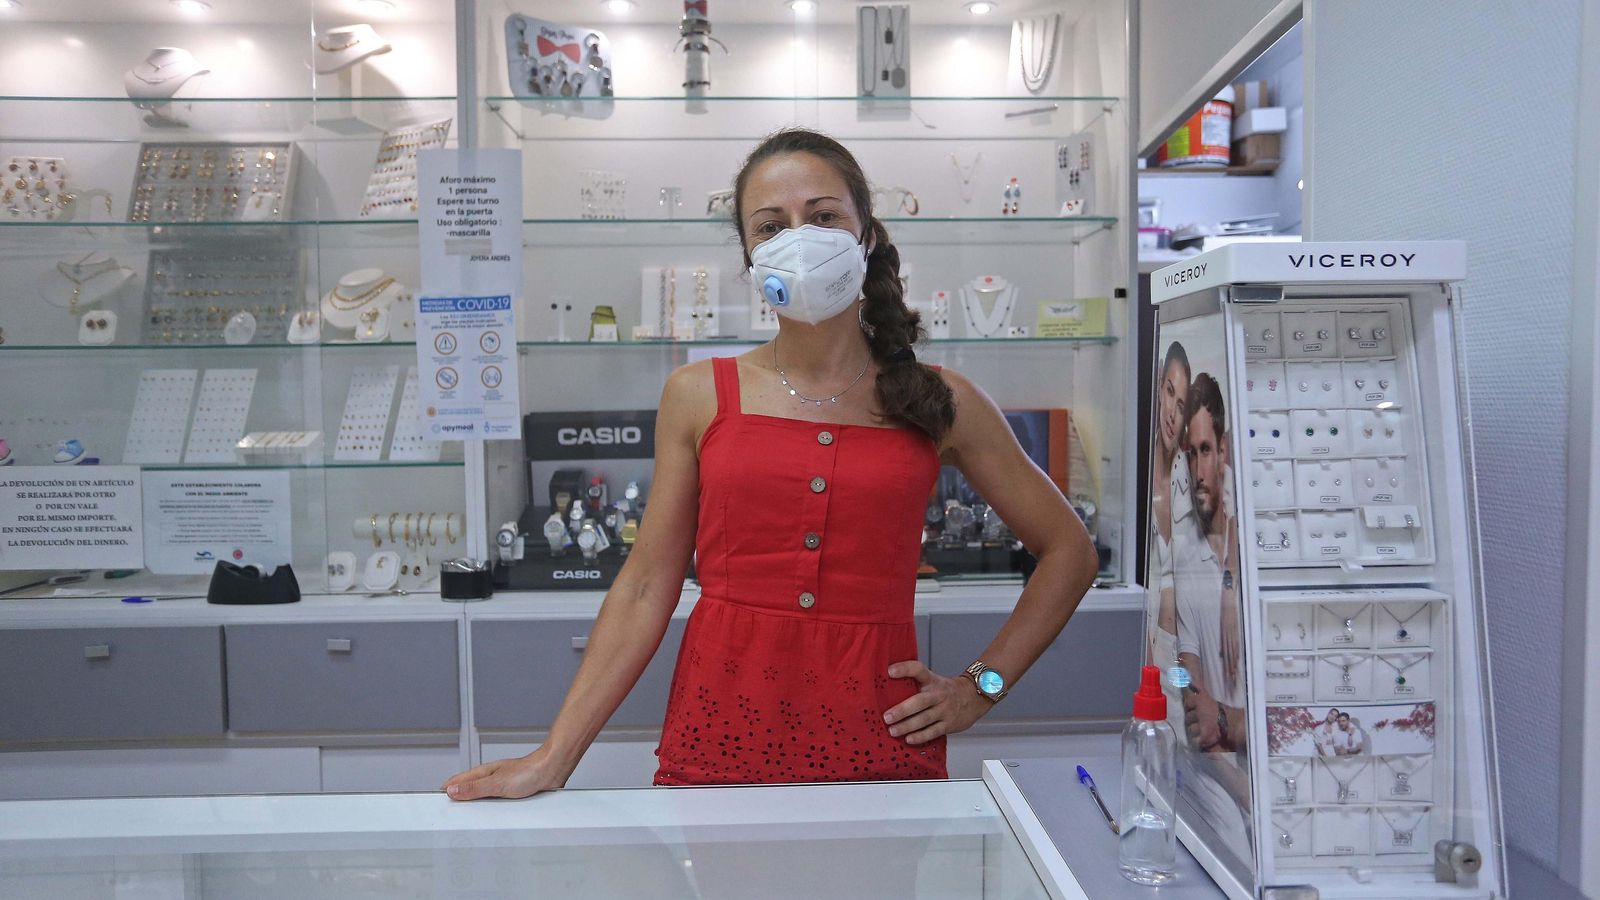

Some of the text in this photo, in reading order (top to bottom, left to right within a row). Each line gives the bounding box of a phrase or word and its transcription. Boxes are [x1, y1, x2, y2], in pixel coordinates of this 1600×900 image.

[440, 176, 496, 184] Aforo máximo
[437, 198, 464, 206] Espere
[454, 218, 497, 227] obligatorio
[1287, 254, 1416, 268] VICEROY
[1164, 262, 1208, 288] VICEROY
[457, 298, 509, 310] COVID-19
[557, 426, 641, 446] CASIO
[9, 479, 65, 487] DEVOLUCIÓN
[92, 479, 134, 487] ARTÍCULO
[15, 525, 50, 533] NINGÚN
[84, 525, 133, 533] EFECTUARÁ
[552, 570, 601, 579] CASIO
